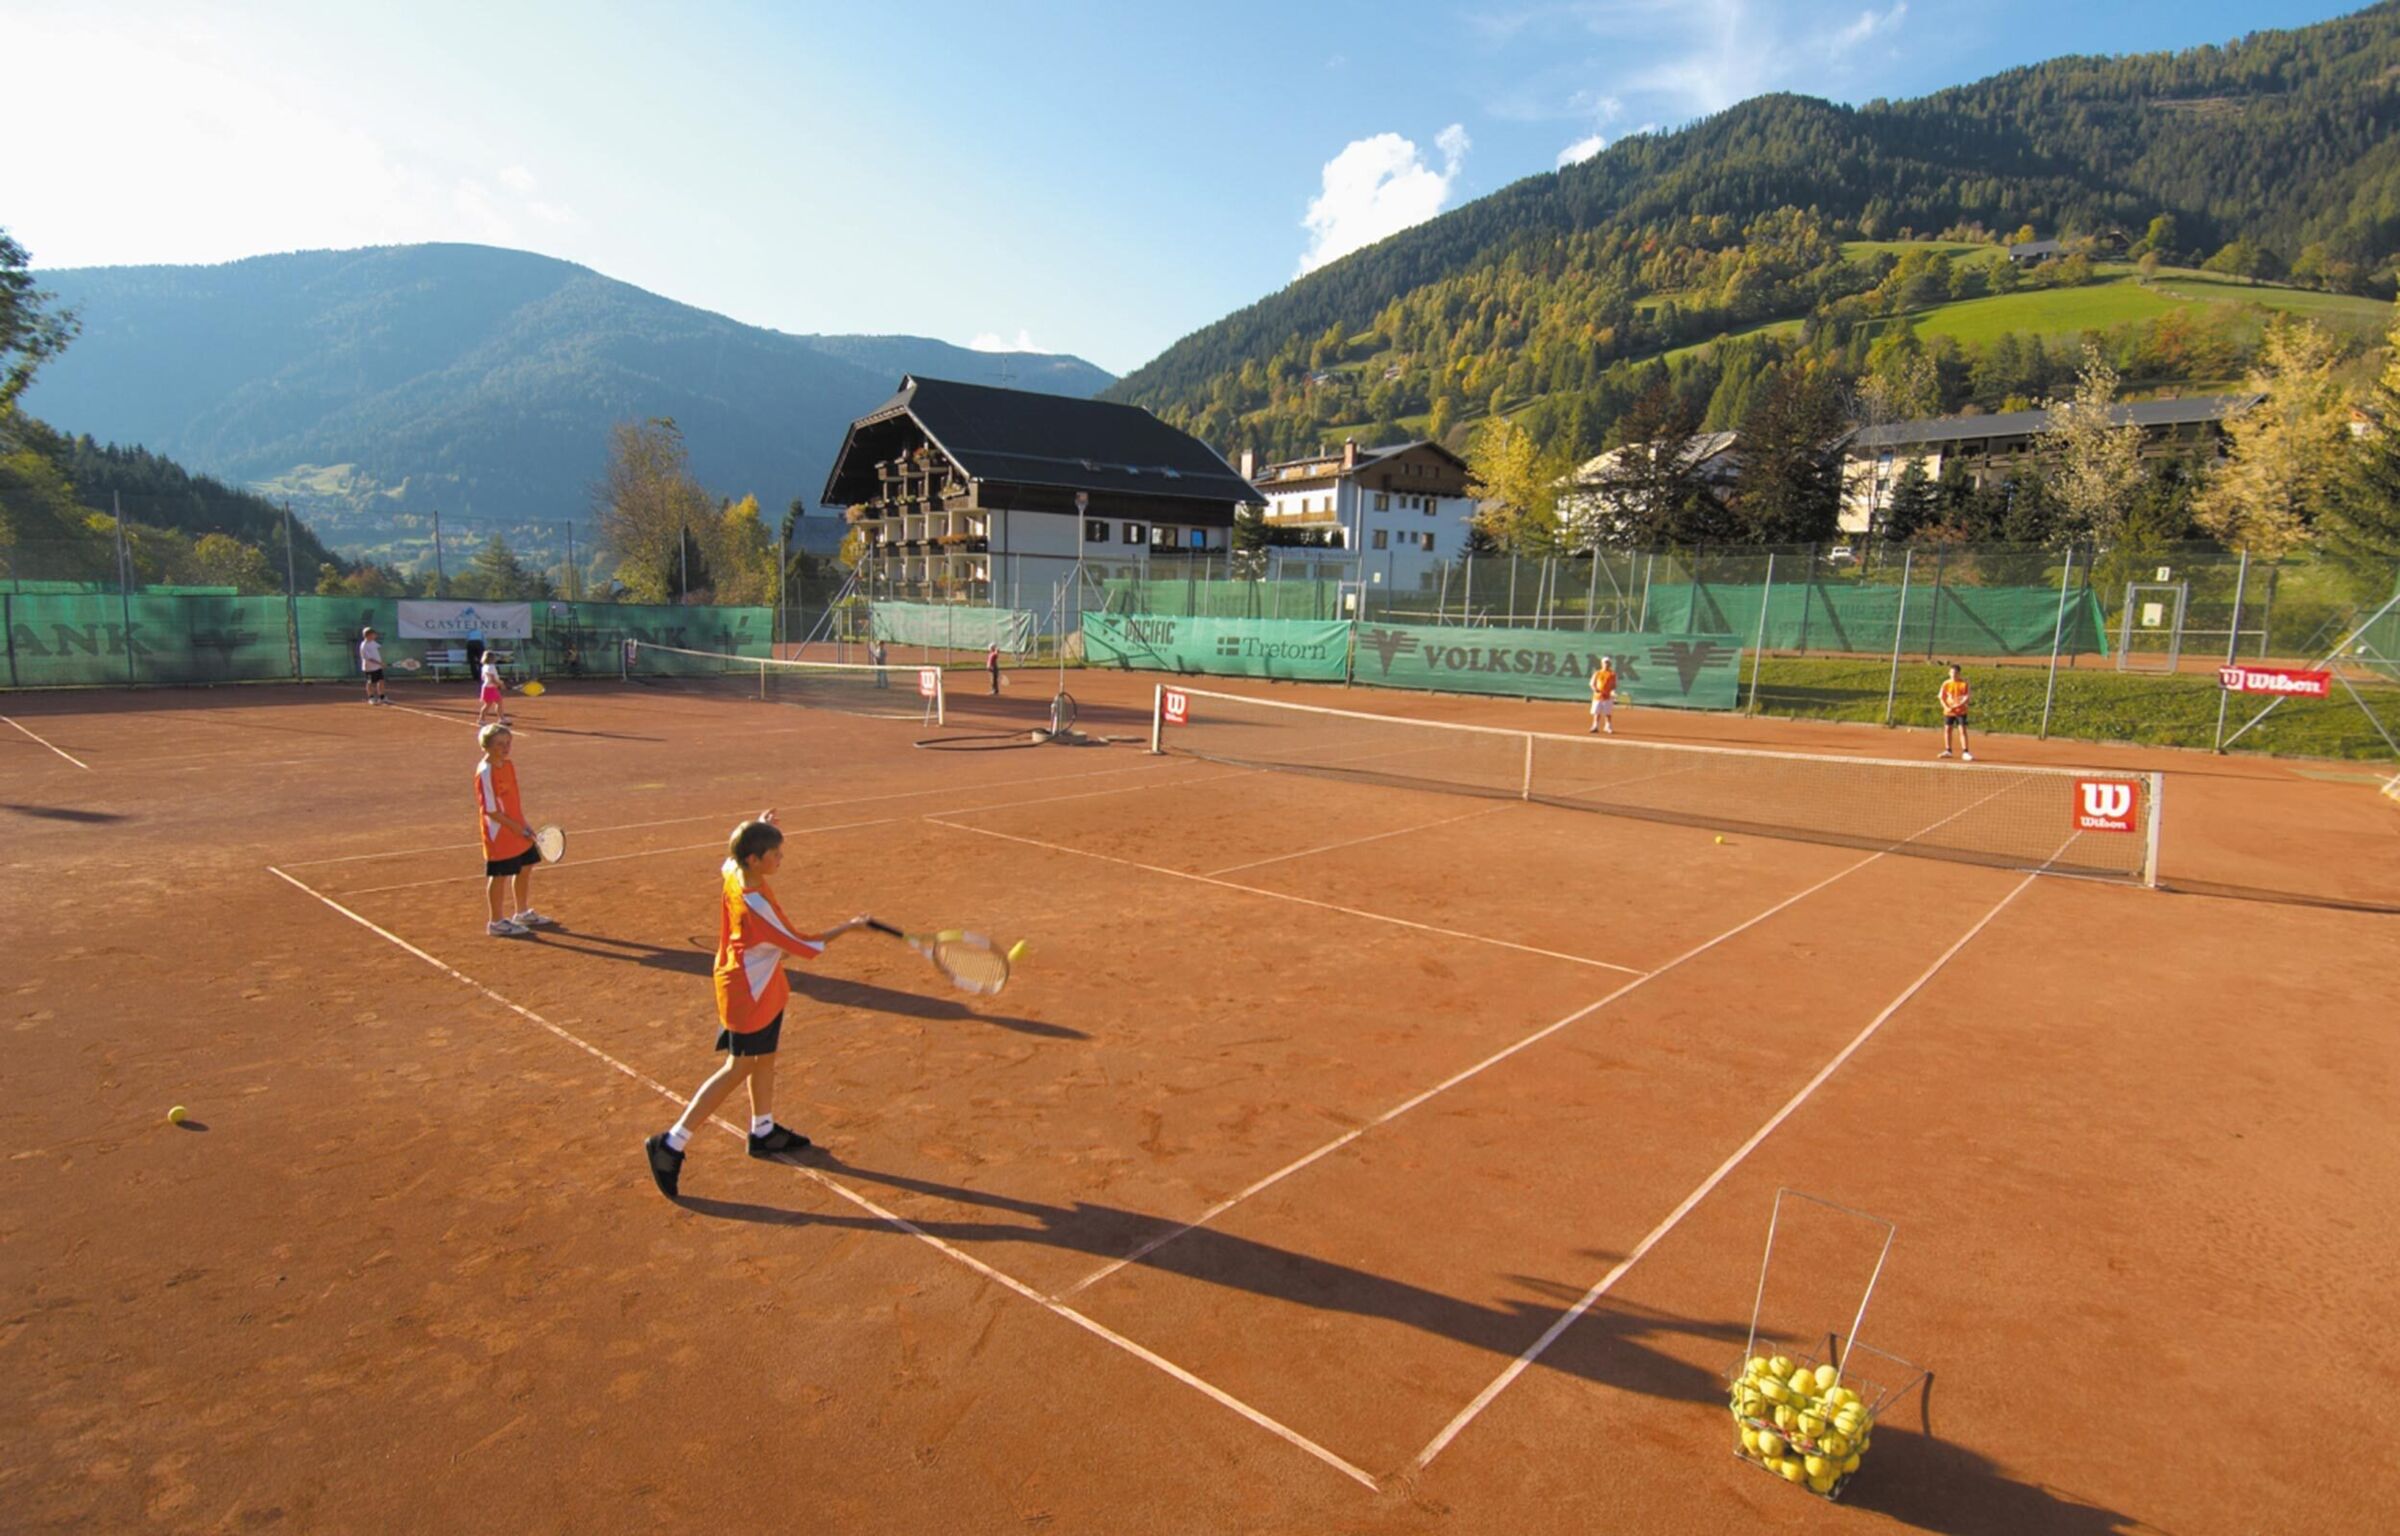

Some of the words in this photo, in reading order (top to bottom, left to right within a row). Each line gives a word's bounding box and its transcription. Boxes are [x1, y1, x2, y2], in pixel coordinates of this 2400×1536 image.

[424, 619, 509, 631] GASTEINER
[1124, 619, 1176, 646] PACIFIC
[1243, 637, 1327, 660] Tretorn
[2247, 673, 2323, 693] Wilson
[2081, 783, 2132, 818] W
[2080, 816, 2128, 830] Wilson
